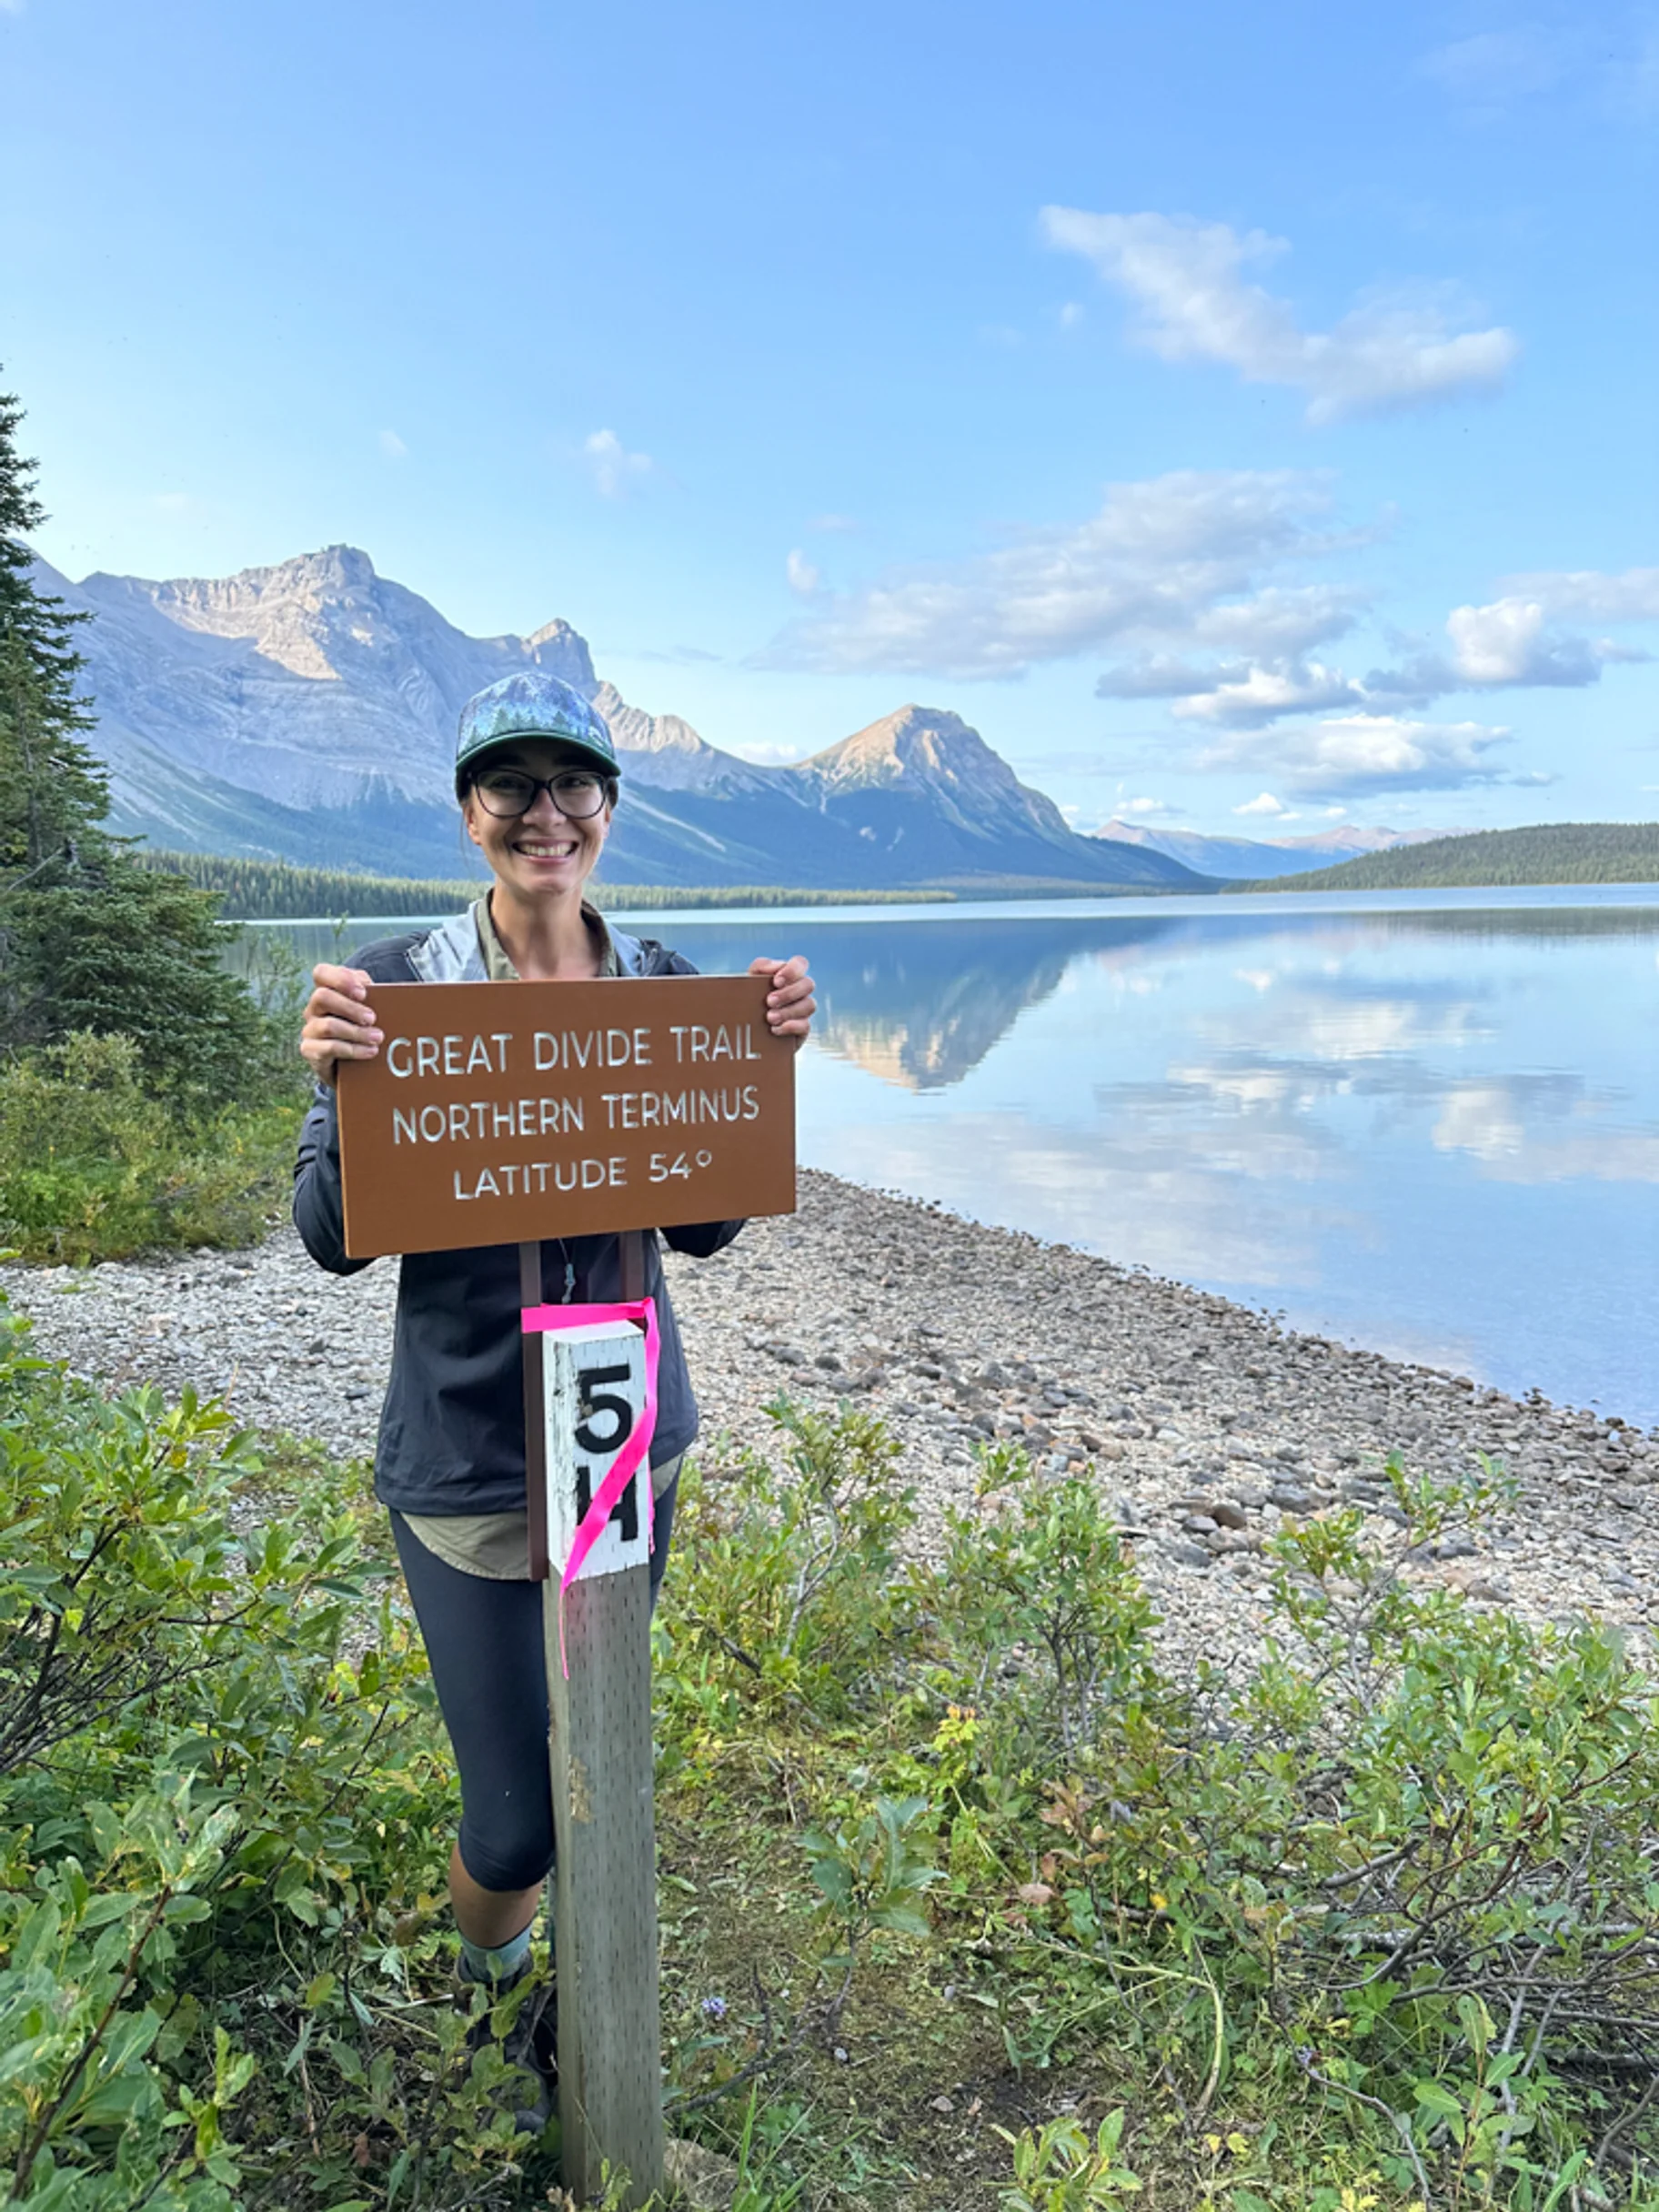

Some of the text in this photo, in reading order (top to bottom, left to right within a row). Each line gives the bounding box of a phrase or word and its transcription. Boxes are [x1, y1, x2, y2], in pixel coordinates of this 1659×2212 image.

[387, 1025, 761, 1078] GREAT DIVIDE TRAIL
[393, 1086, 759, 1144] NORTHERN TERMINUS
[455, 1150, 712, 1200] LATITUDE 54°
[575, 1364, 631, 1454] 5
